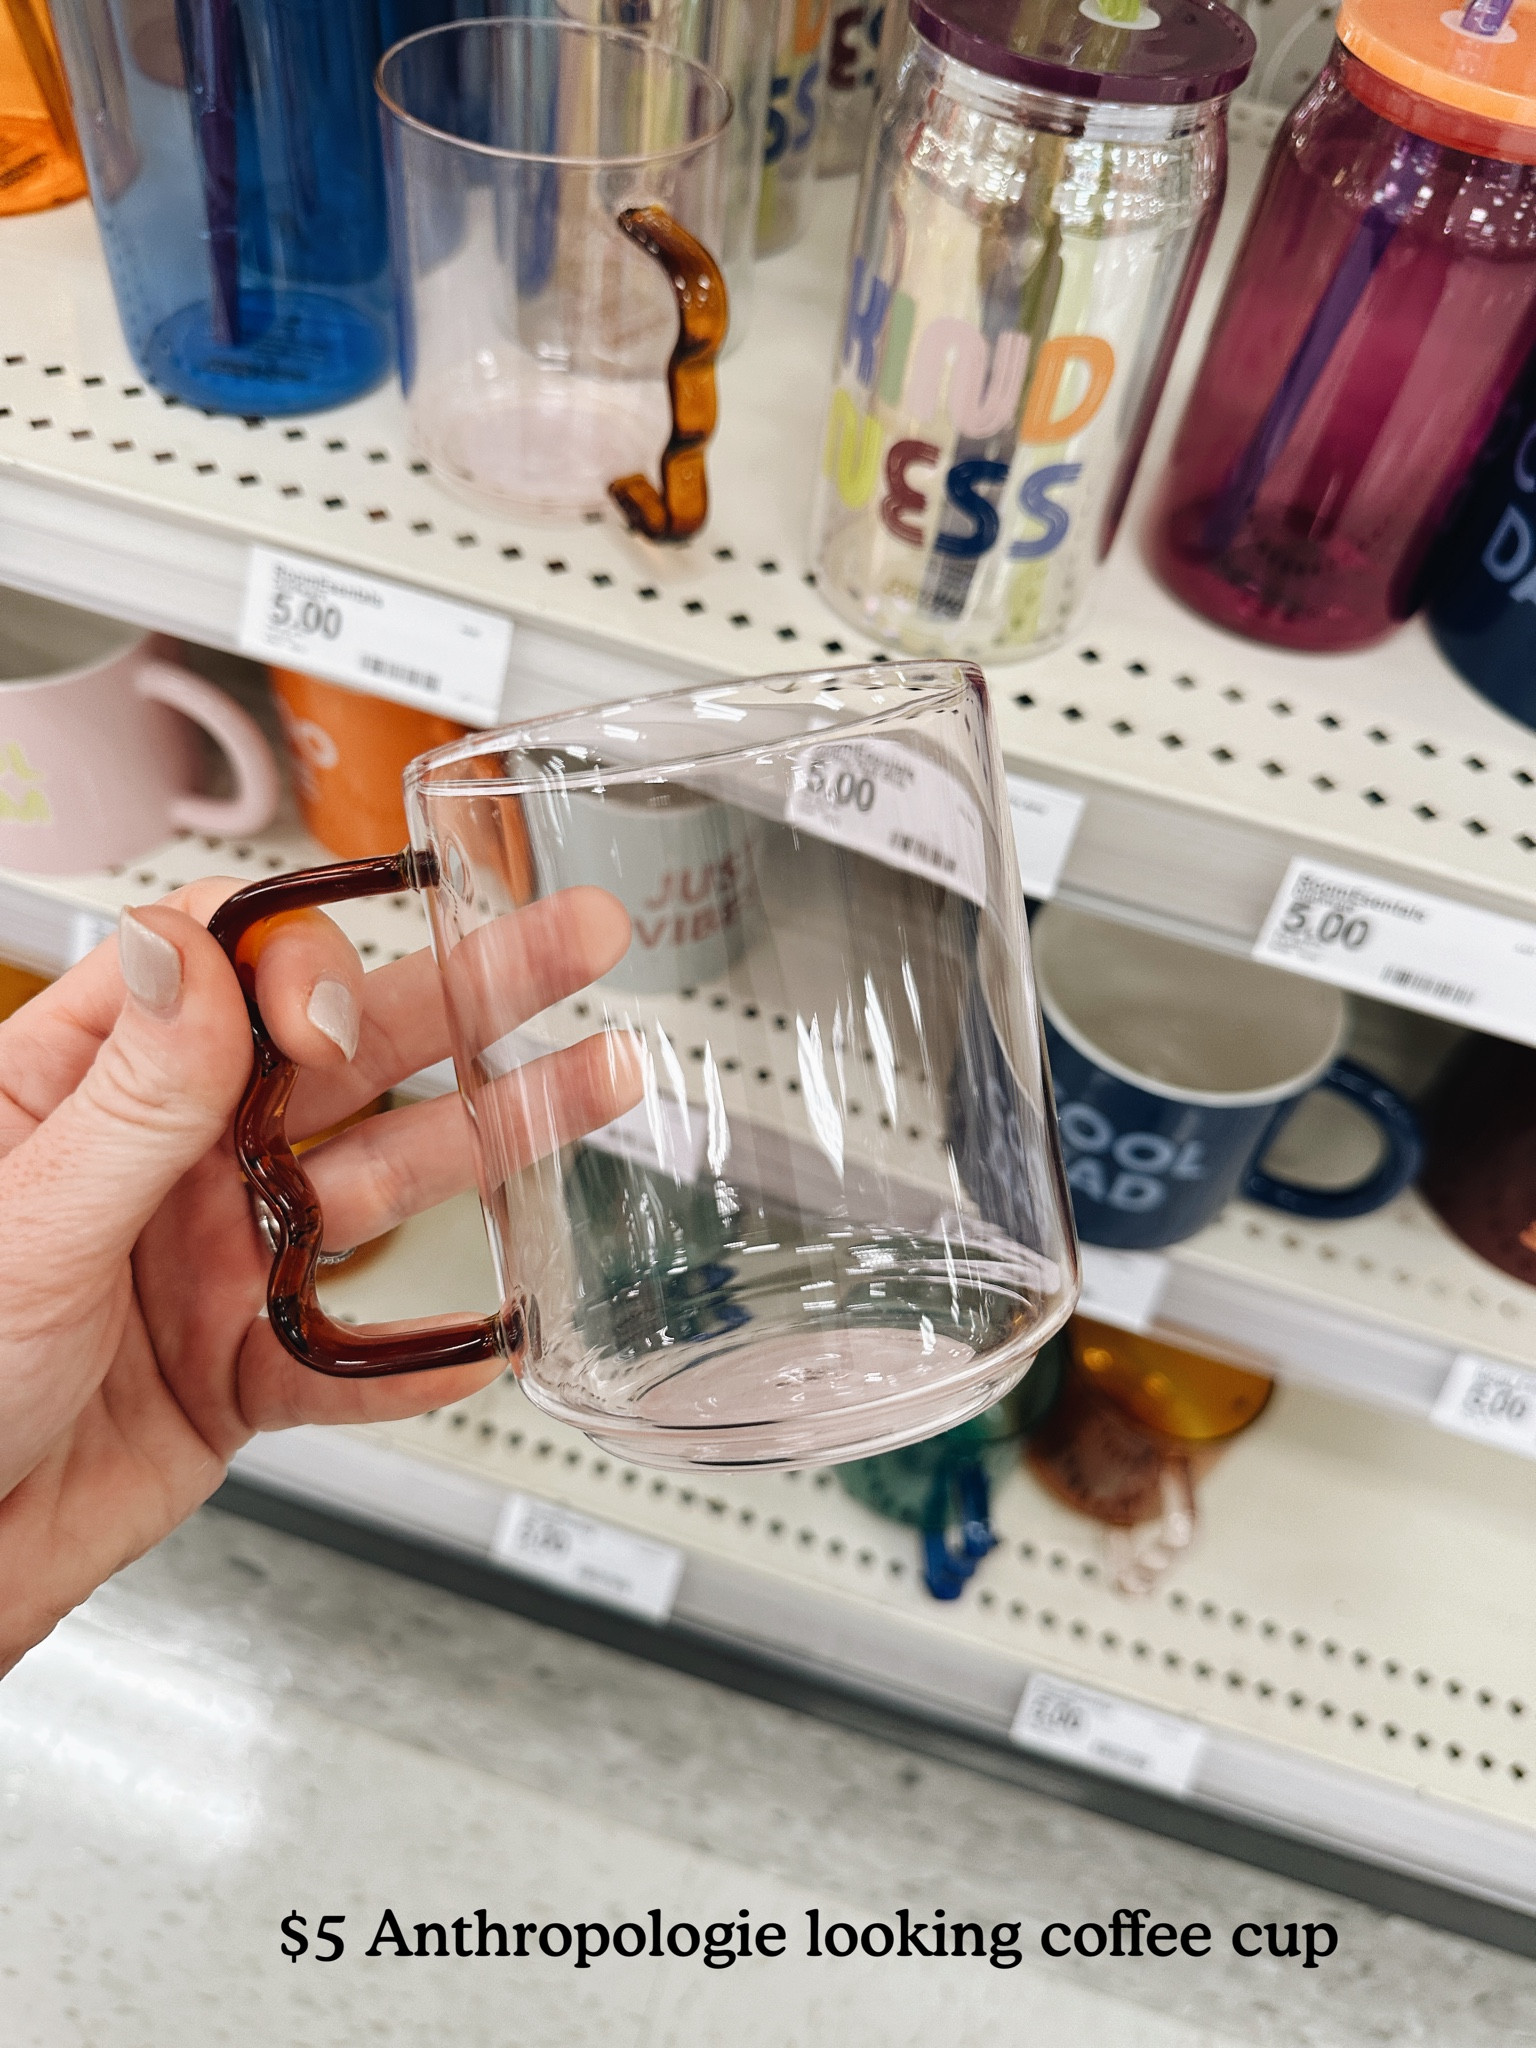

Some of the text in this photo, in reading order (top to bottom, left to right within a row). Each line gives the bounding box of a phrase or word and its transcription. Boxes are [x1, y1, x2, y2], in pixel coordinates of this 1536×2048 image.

[842, 255, 1115, 446] KIND
[823, 387, 1083, 563] NESS
[269, 592, 343, 641] 5.00
[806, 758, 876, 812] 5.00
[1282, 902, 1370, 952] 5.00
[1050, 1082, 1205, 1182] OOL
[1062, 1152, 1168, 1213] AD
